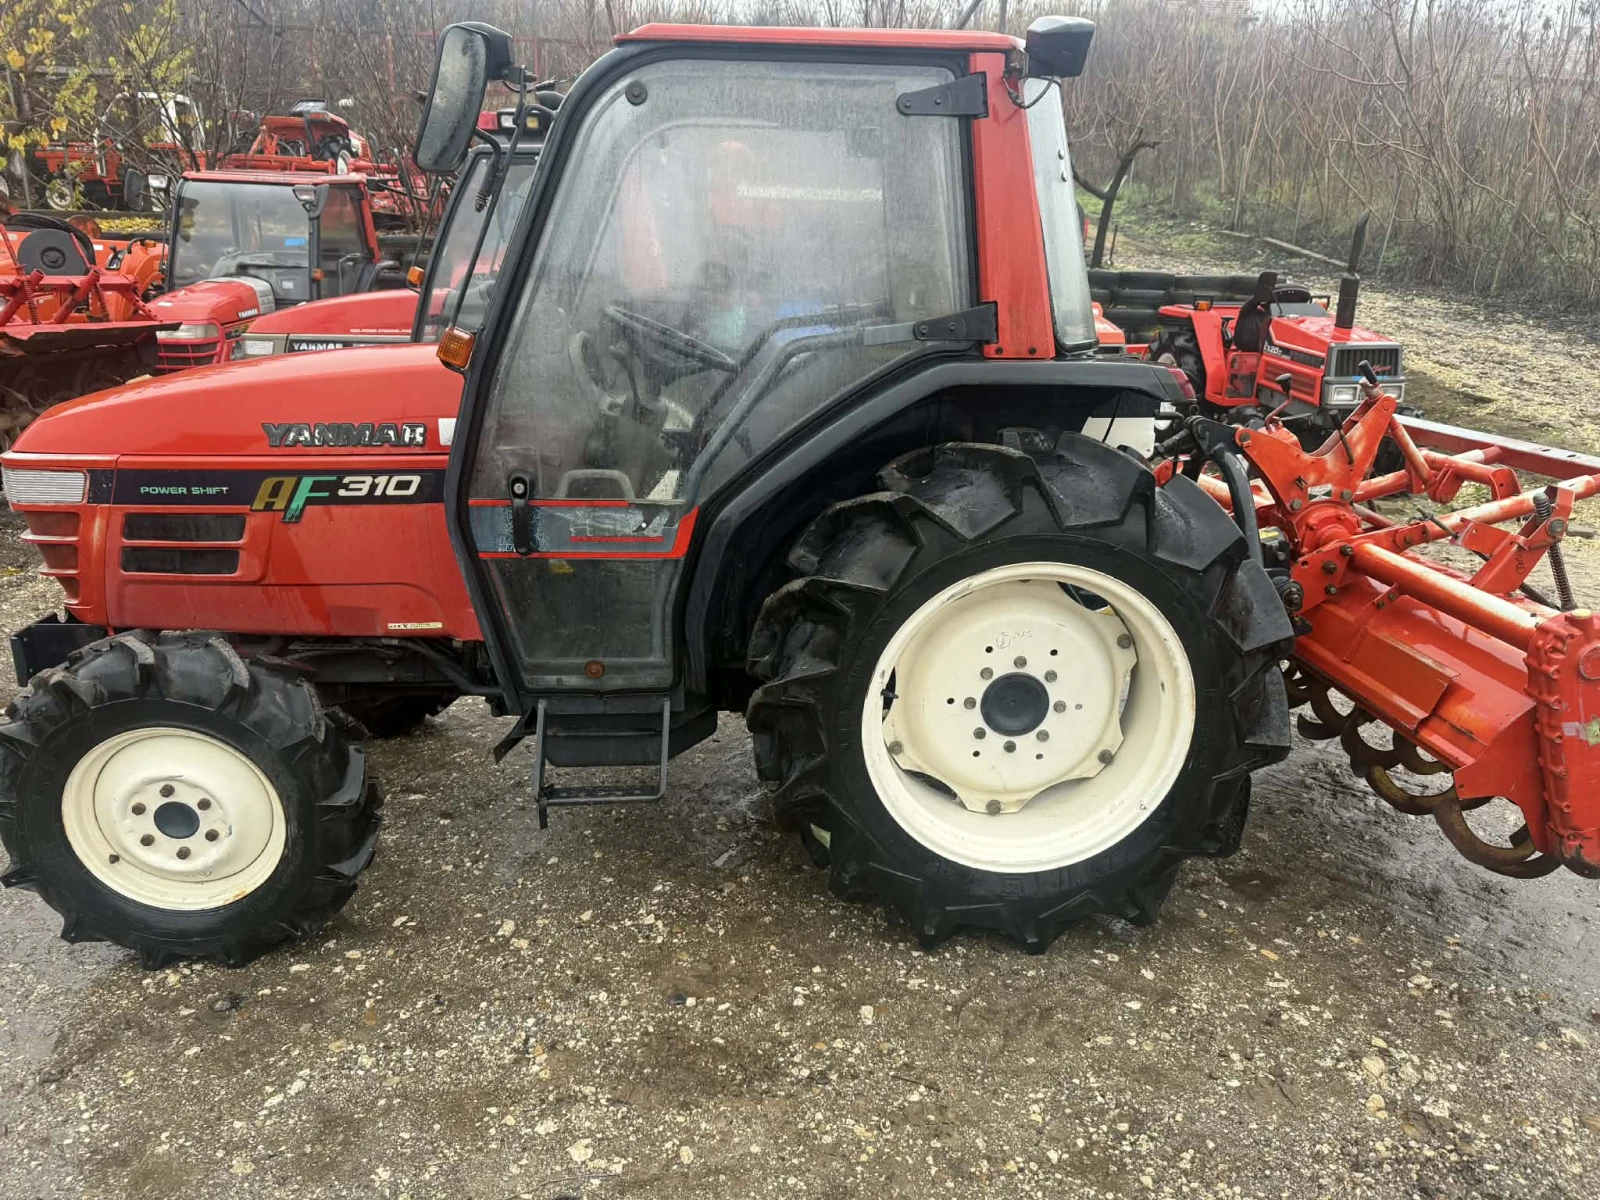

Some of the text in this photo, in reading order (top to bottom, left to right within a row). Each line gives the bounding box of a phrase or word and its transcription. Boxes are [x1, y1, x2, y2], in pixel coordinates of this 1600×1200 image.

[237, 307, 259, 319] YANMAR
[292, 342, 344, 351] YANMAR
[262, 422, 426, 447] YANMAR
[140, 486, 229, 495] POWER SHIFT
